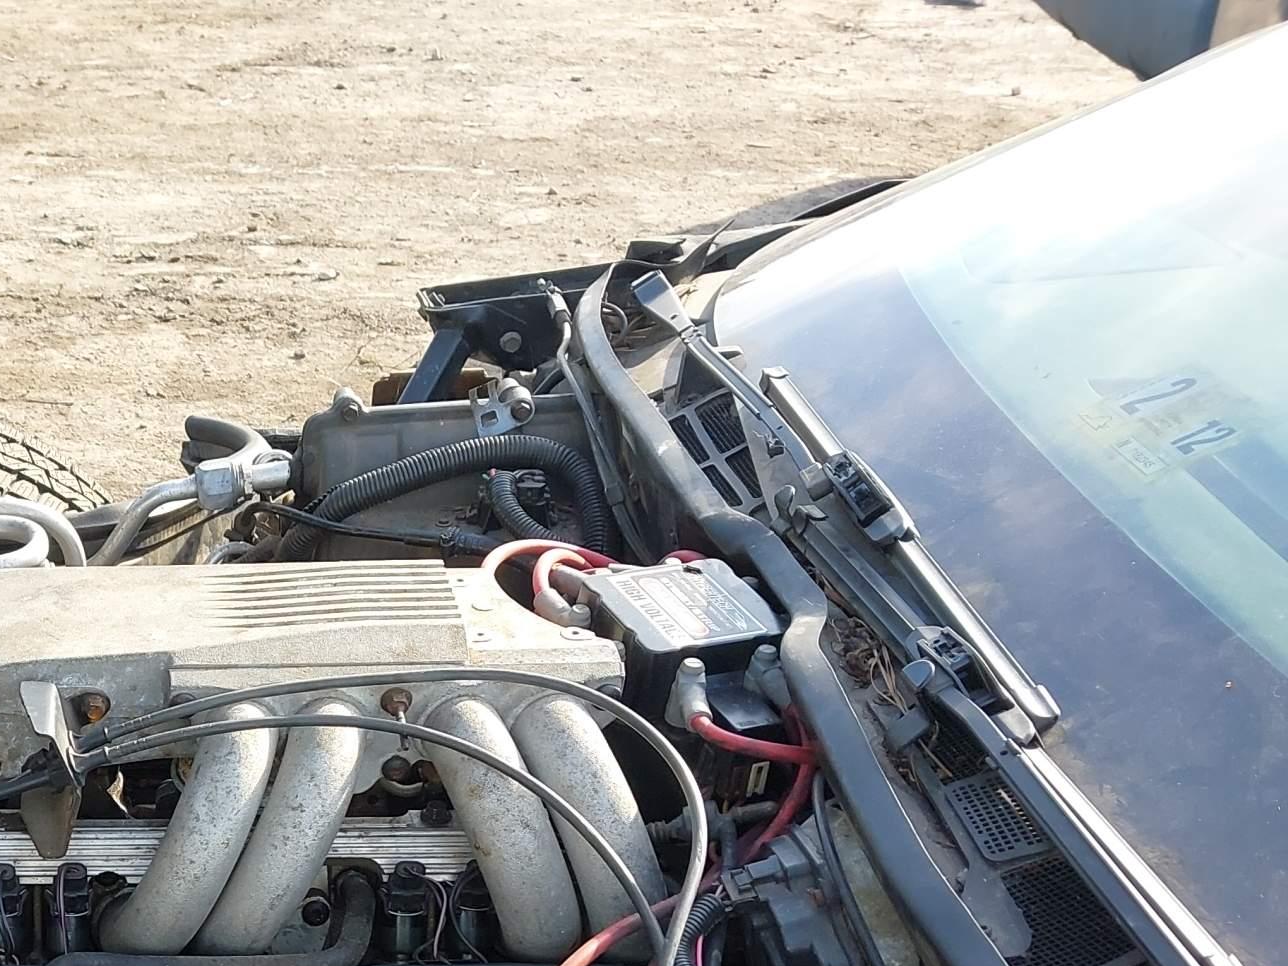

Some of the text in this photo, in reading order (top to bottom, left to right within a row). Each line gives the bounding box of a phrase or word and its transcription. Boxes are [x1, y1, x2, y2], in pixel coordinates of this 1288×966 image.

[1119, 377, 1197, 416] 2
[1170, 420, 1238, 455] 12
[616, 579, 645, 603] HIGH
